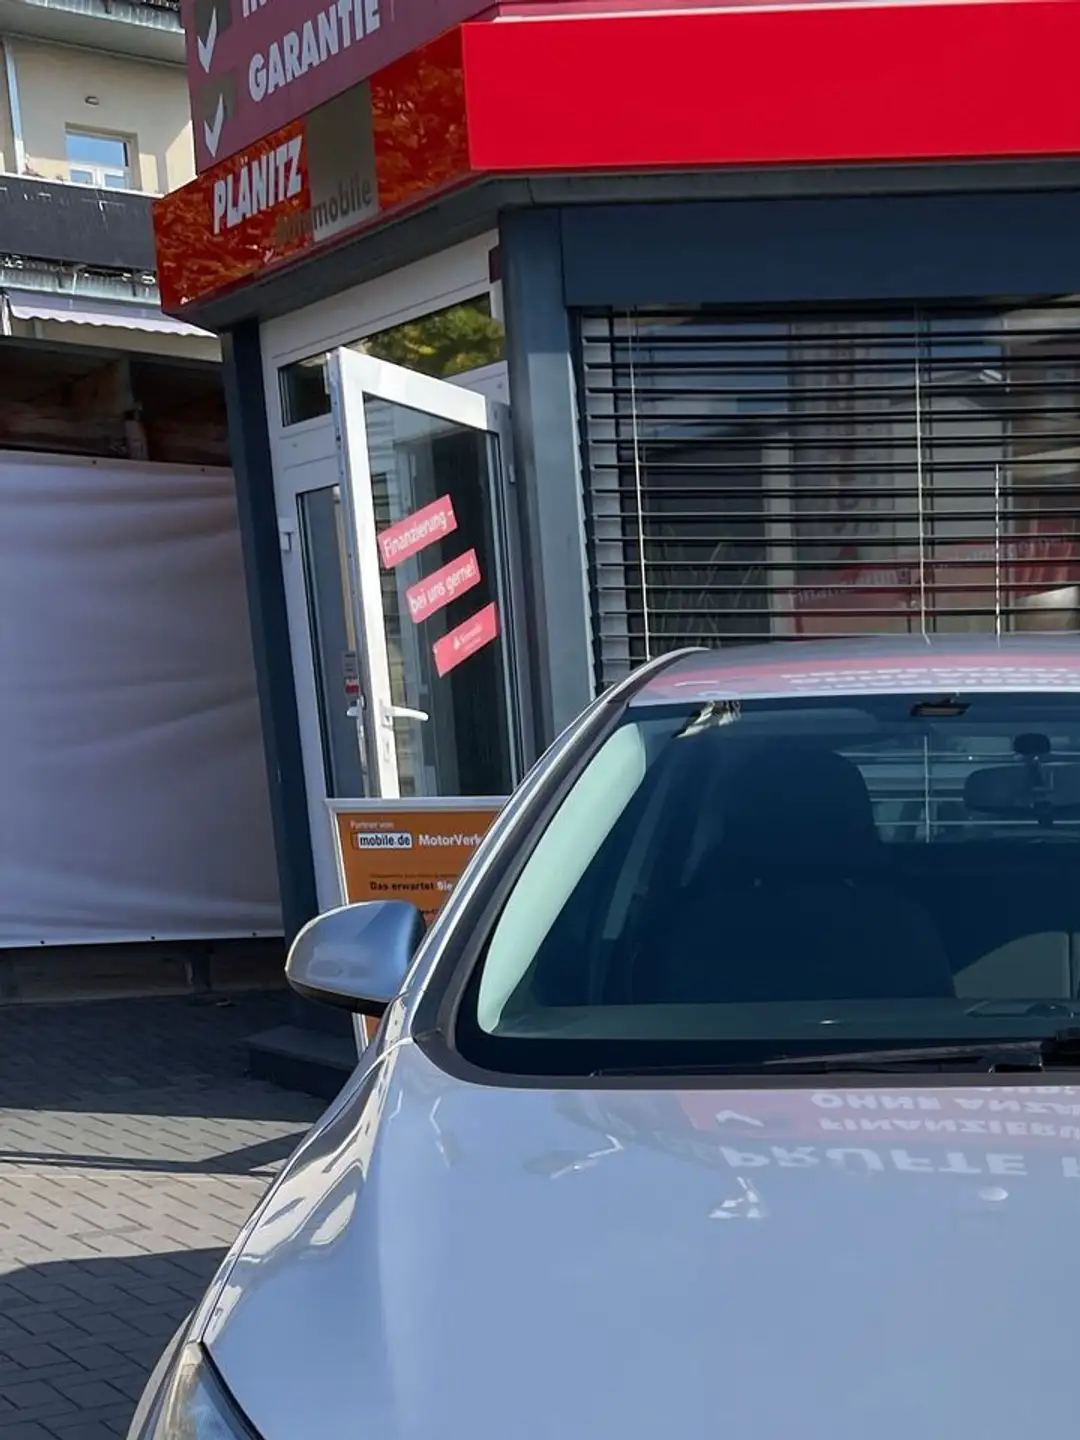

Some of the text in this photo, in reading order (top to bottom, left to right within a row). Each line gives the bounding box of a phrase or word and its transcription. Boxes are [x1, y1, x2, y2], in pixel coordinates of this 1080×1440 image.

[248, 0, 381, 102] GARANTIE
[213, 135, 303, 235] PLÄNITZ
[384, 509, 448, 558] Finanzierung
[409, 592, 427, 613] bei
[427, 583, 446, 603] uns
[360, 833, 411, 846] mobile.de
